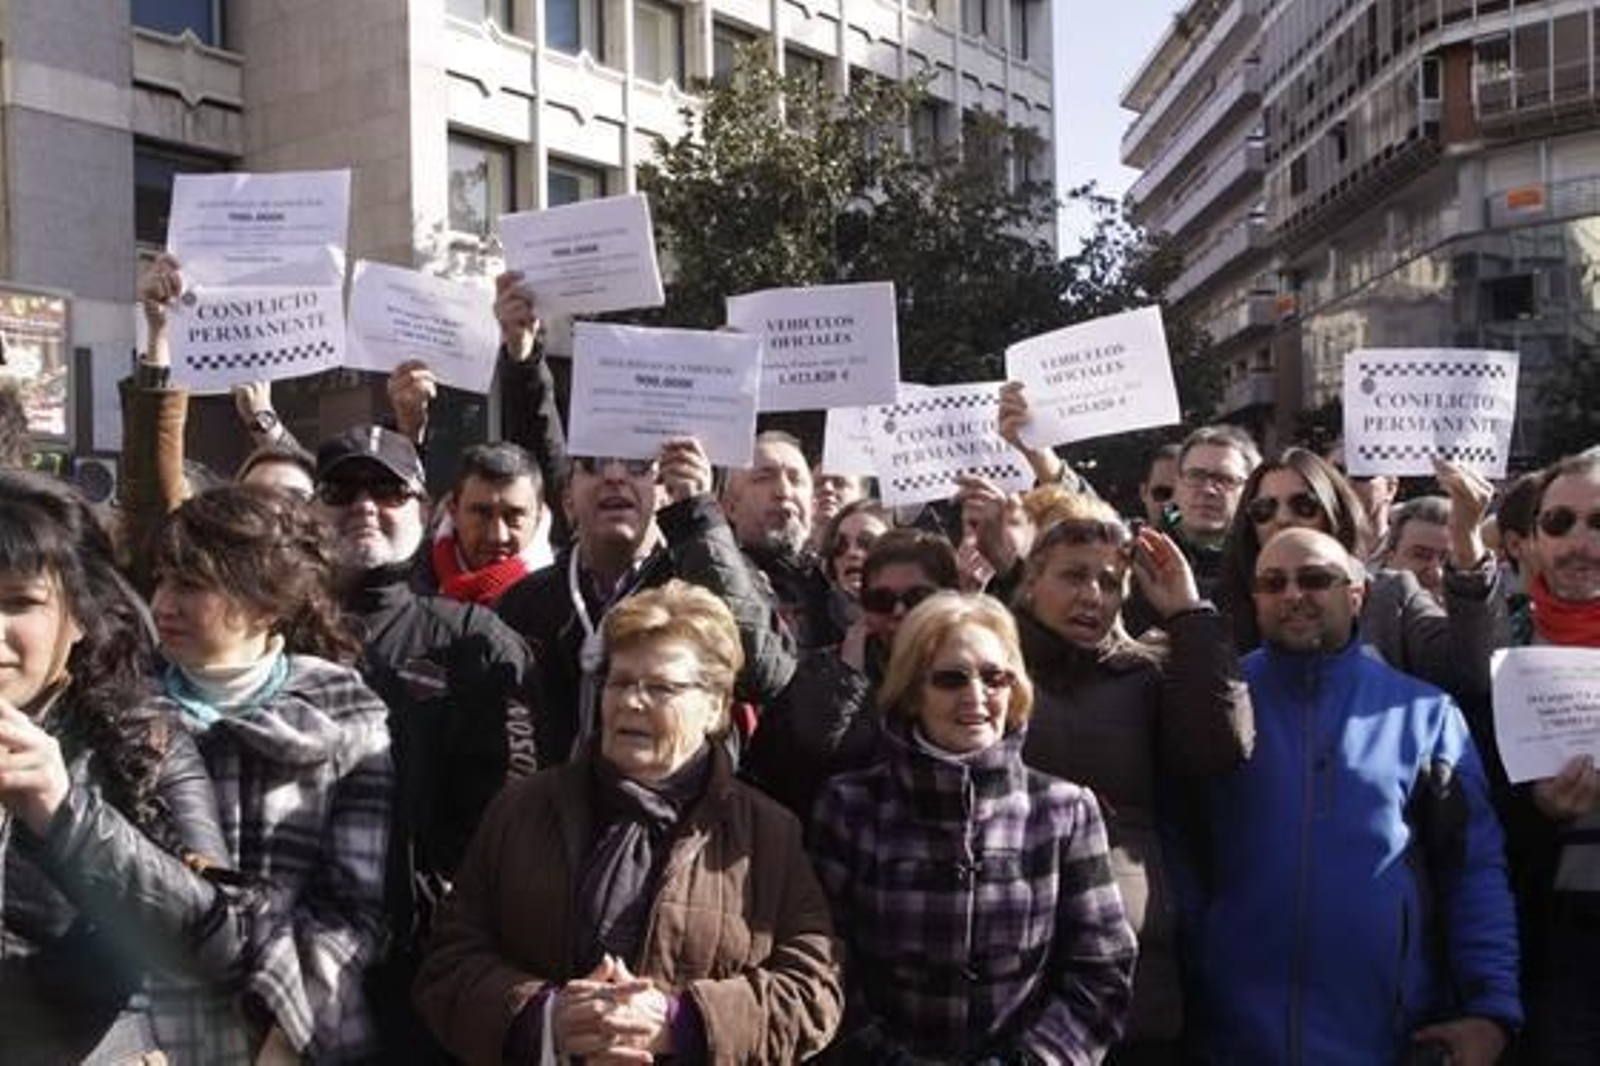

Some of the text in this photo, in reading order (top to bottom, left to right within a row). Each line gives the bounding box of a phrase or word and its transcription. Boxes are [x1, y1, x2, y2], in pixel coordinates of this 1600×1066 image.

[196, 291, 318, 320] CONFLICTO
[188, 312, 328, 342] PERMANENTE
[766, 316, 855, 331] VEHICULOS
[770, 332, 853, 349] OFICIALES
[1040, 343, 1127, 371] VEHICULOS
[1045, 360, 1125, 386] OFICIALES
[1374, 392, 1495, 411] CONFLICTO
[1363, 415, 1501, 433] PERMANENTE
